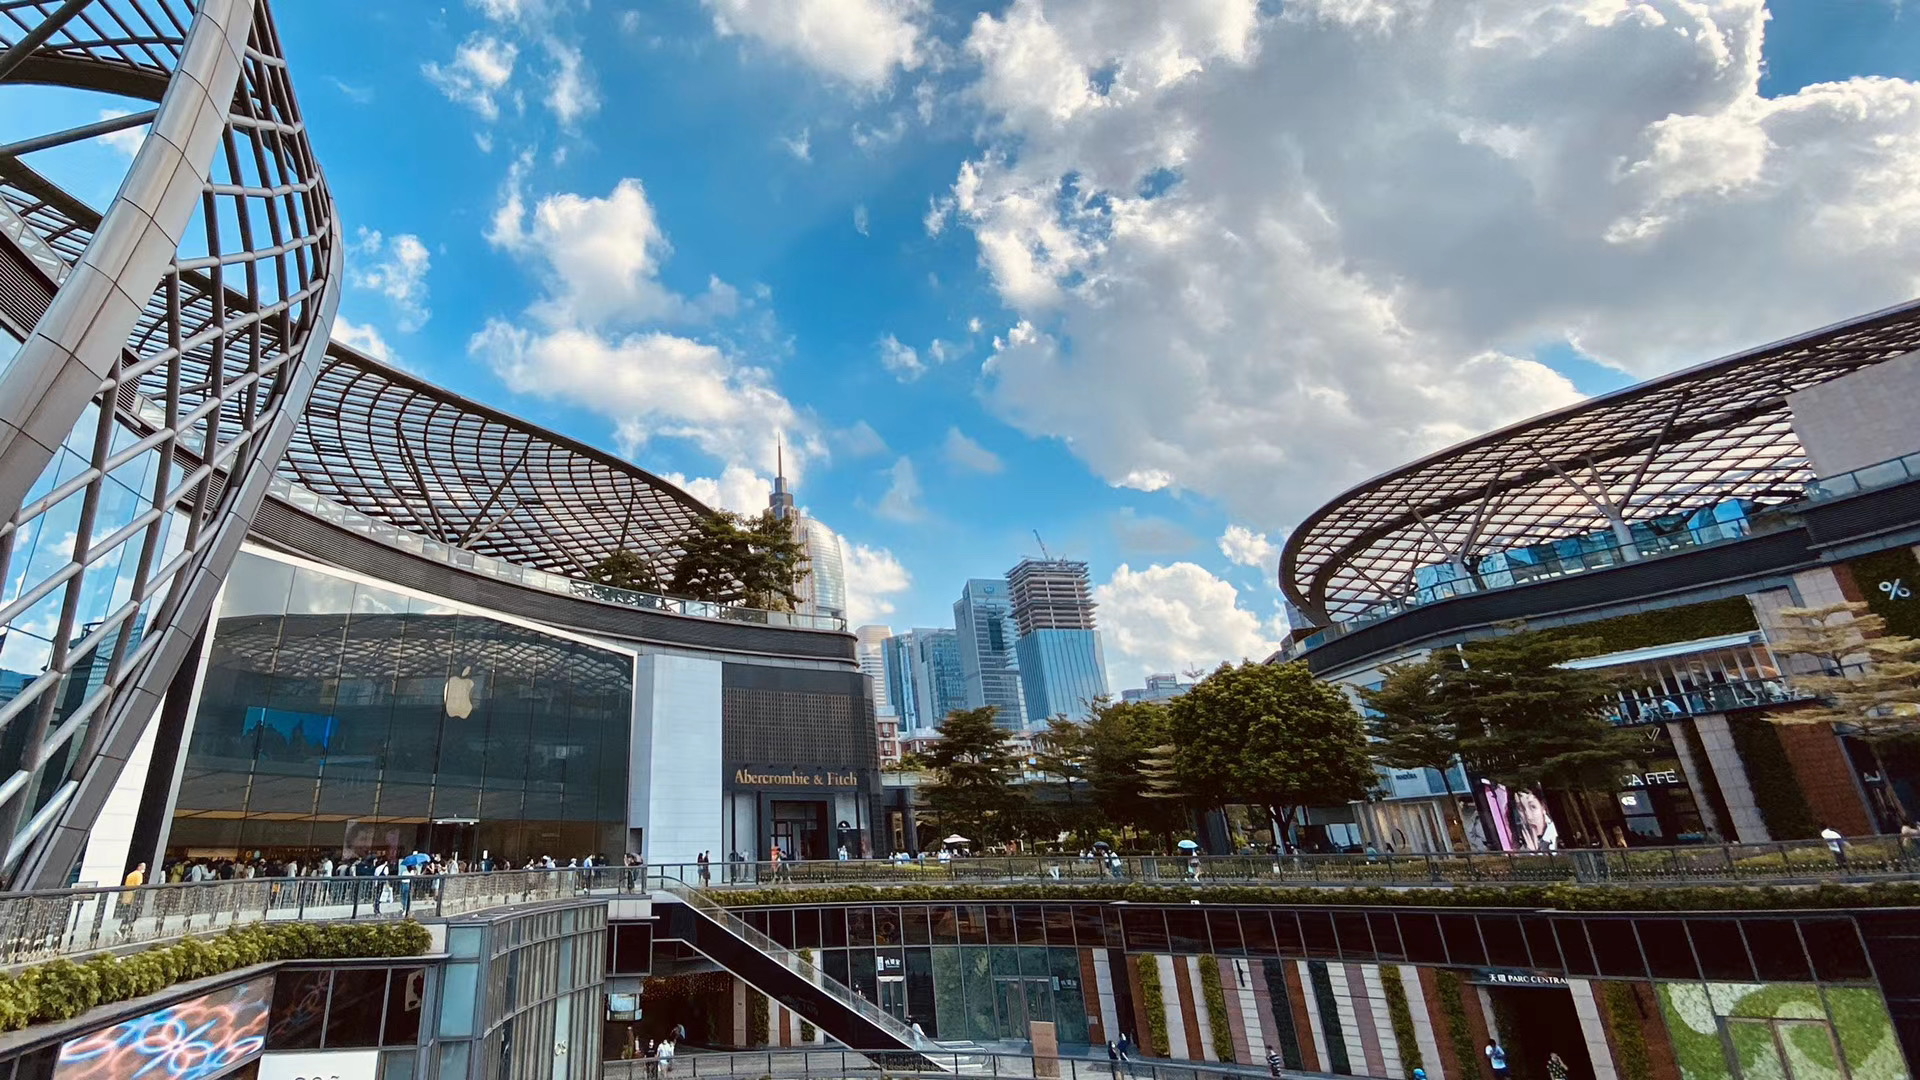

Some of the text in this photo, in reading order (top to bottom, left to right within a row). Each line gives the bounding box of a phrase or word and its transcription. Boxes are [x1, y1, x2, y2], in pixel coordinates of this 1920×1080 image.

[735, 769, 858, 786] Abercrombie & Fitch
[1507, 974, 1530, 983] PARC
